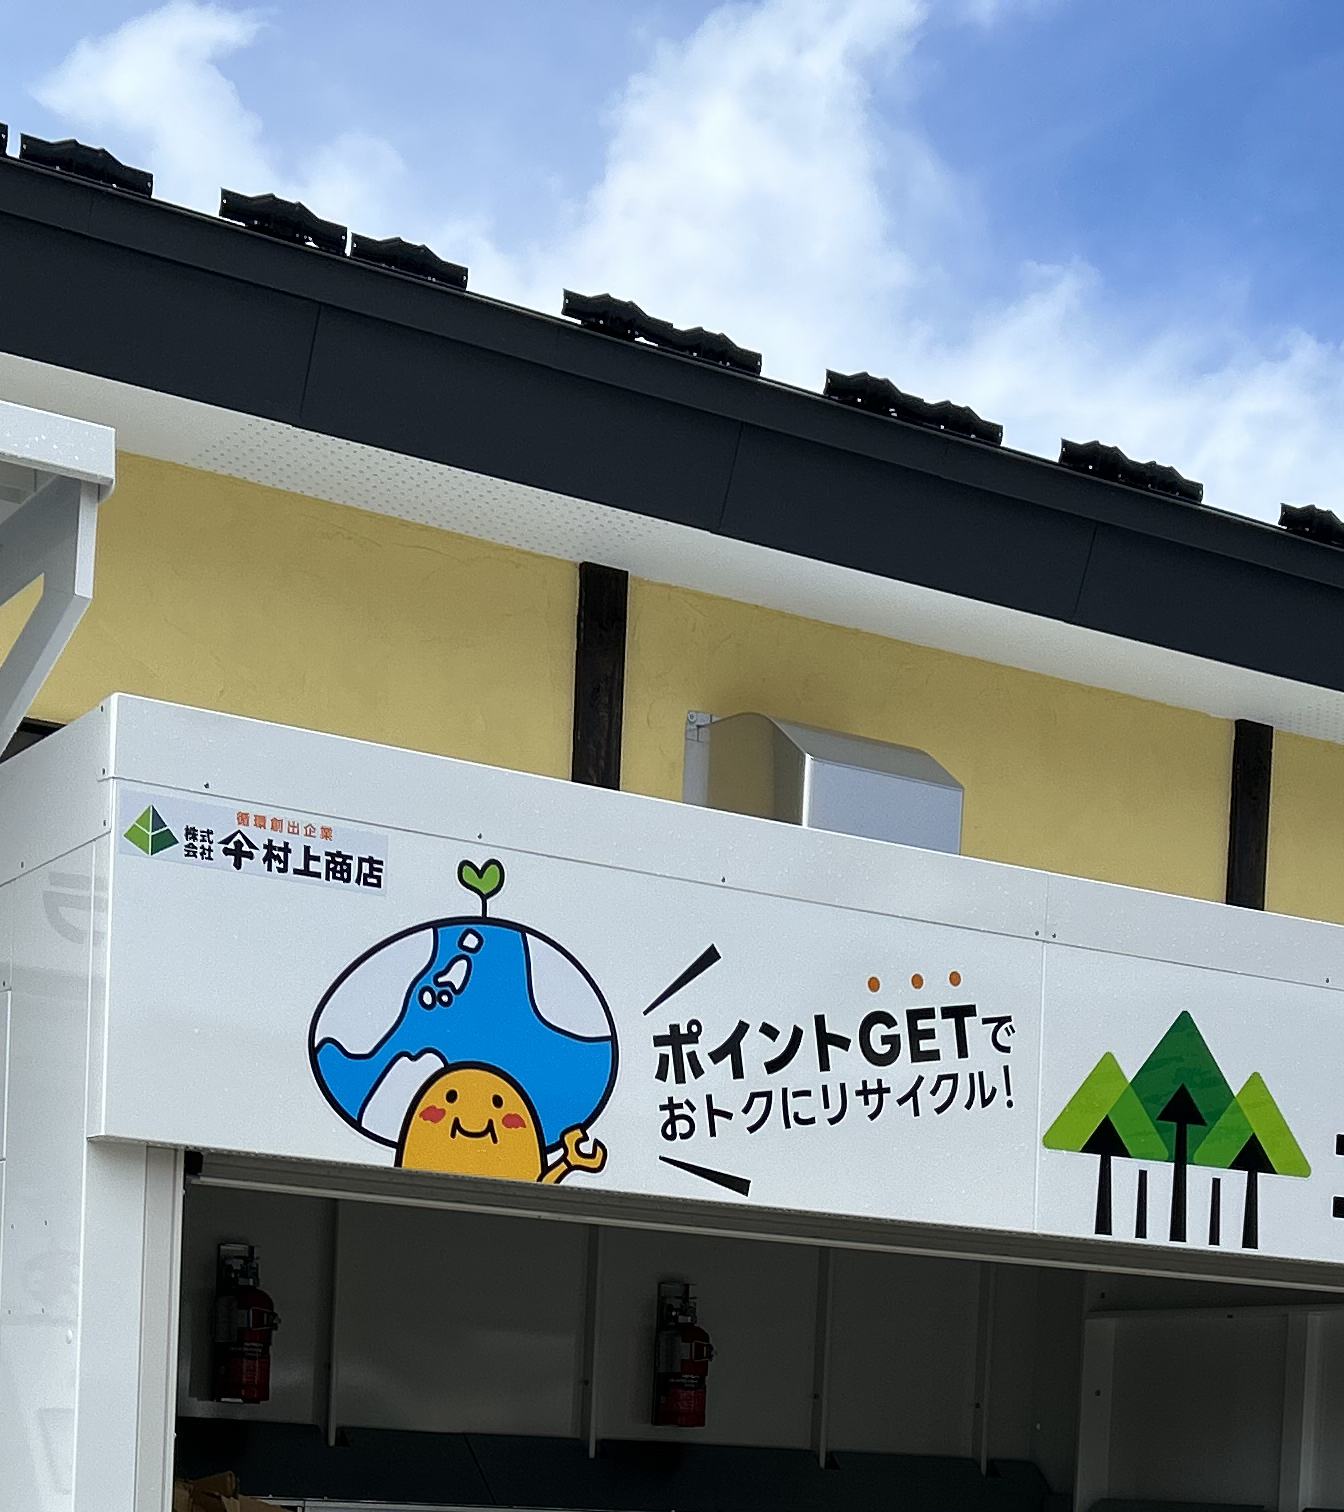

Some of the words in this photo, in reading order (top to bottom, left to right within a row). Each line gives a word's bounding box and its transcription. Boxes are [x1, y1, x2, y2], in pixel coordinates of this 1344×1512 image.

[184, 825, 214, 845] 株式
[236, 811, 333, 841] 循環創出企業
[183, 843, 214, 861] 会社
[653, 1004, 1017, 1085] ポイントGETで
[659, 1064, 1015, 1142] おトクにリサイクル!
